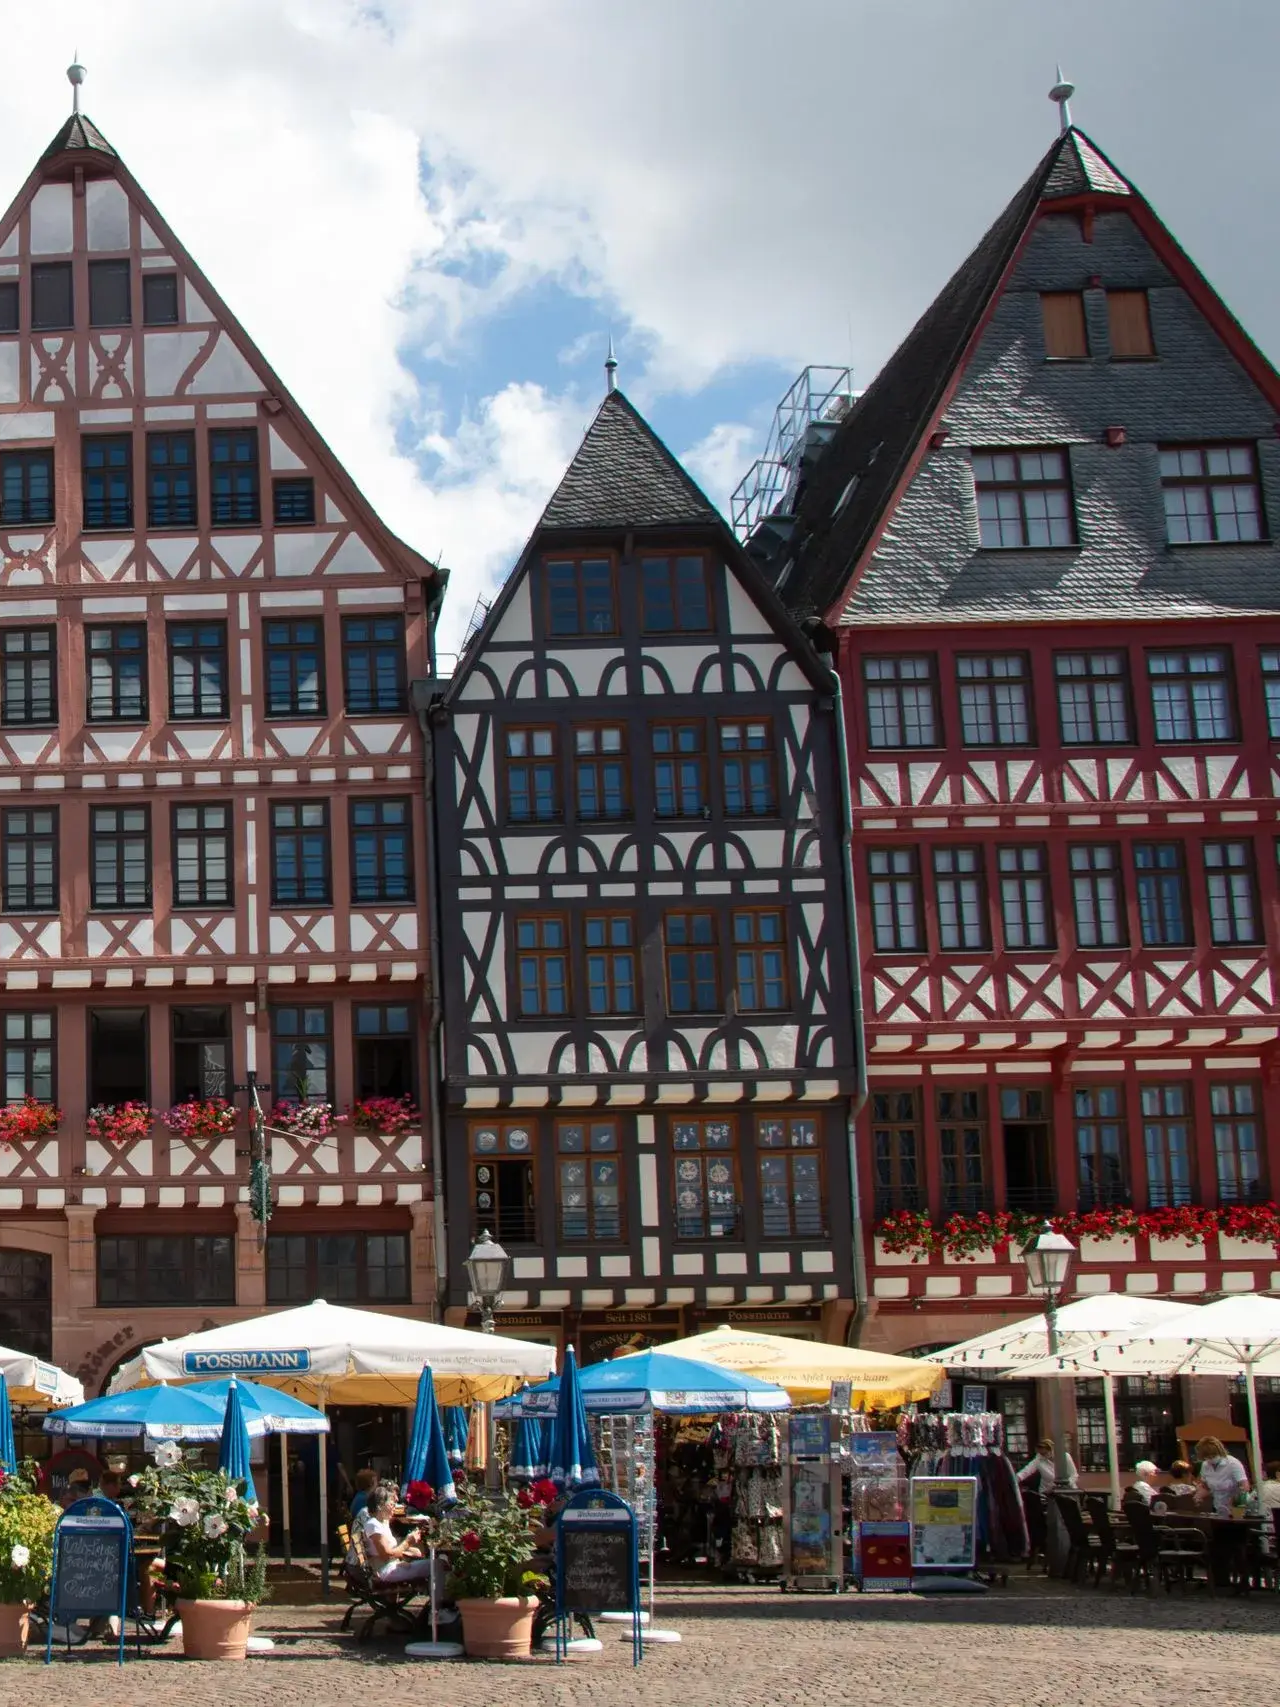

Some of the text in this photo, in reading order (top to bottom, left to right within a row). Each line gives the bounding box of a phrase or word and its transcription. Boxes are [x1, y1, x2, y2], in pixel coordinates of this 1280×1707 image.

[606, 1312, 652, 1323] Seit 1881
[728, 1311, 790, 1320] Possmann
[194, 1352, 299, 1369] POSSMANN
